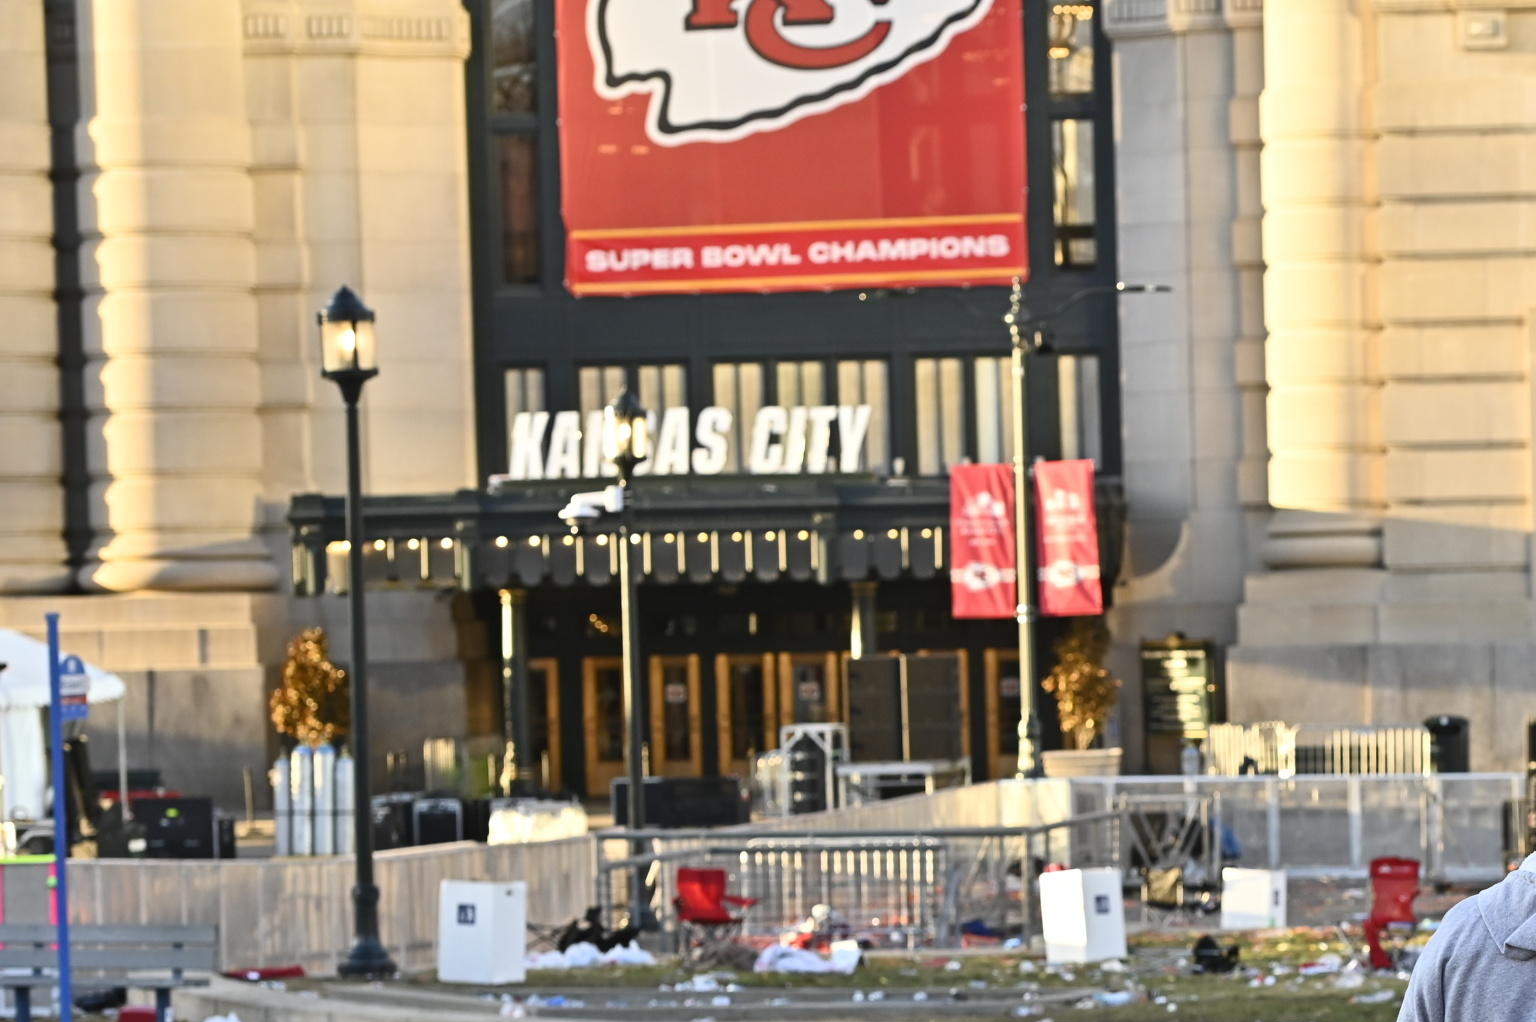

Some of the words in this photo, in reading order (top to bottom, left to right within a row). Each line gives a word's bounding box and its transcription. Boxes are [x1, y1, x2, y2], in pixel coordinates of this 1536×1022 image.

[585, 249, 694, 272] SUPER
[701, 243, 800, 268] BOWL
[808, 234, 1010, 263] CHAMPIONS
[750, 405, 872, 474] CITY
